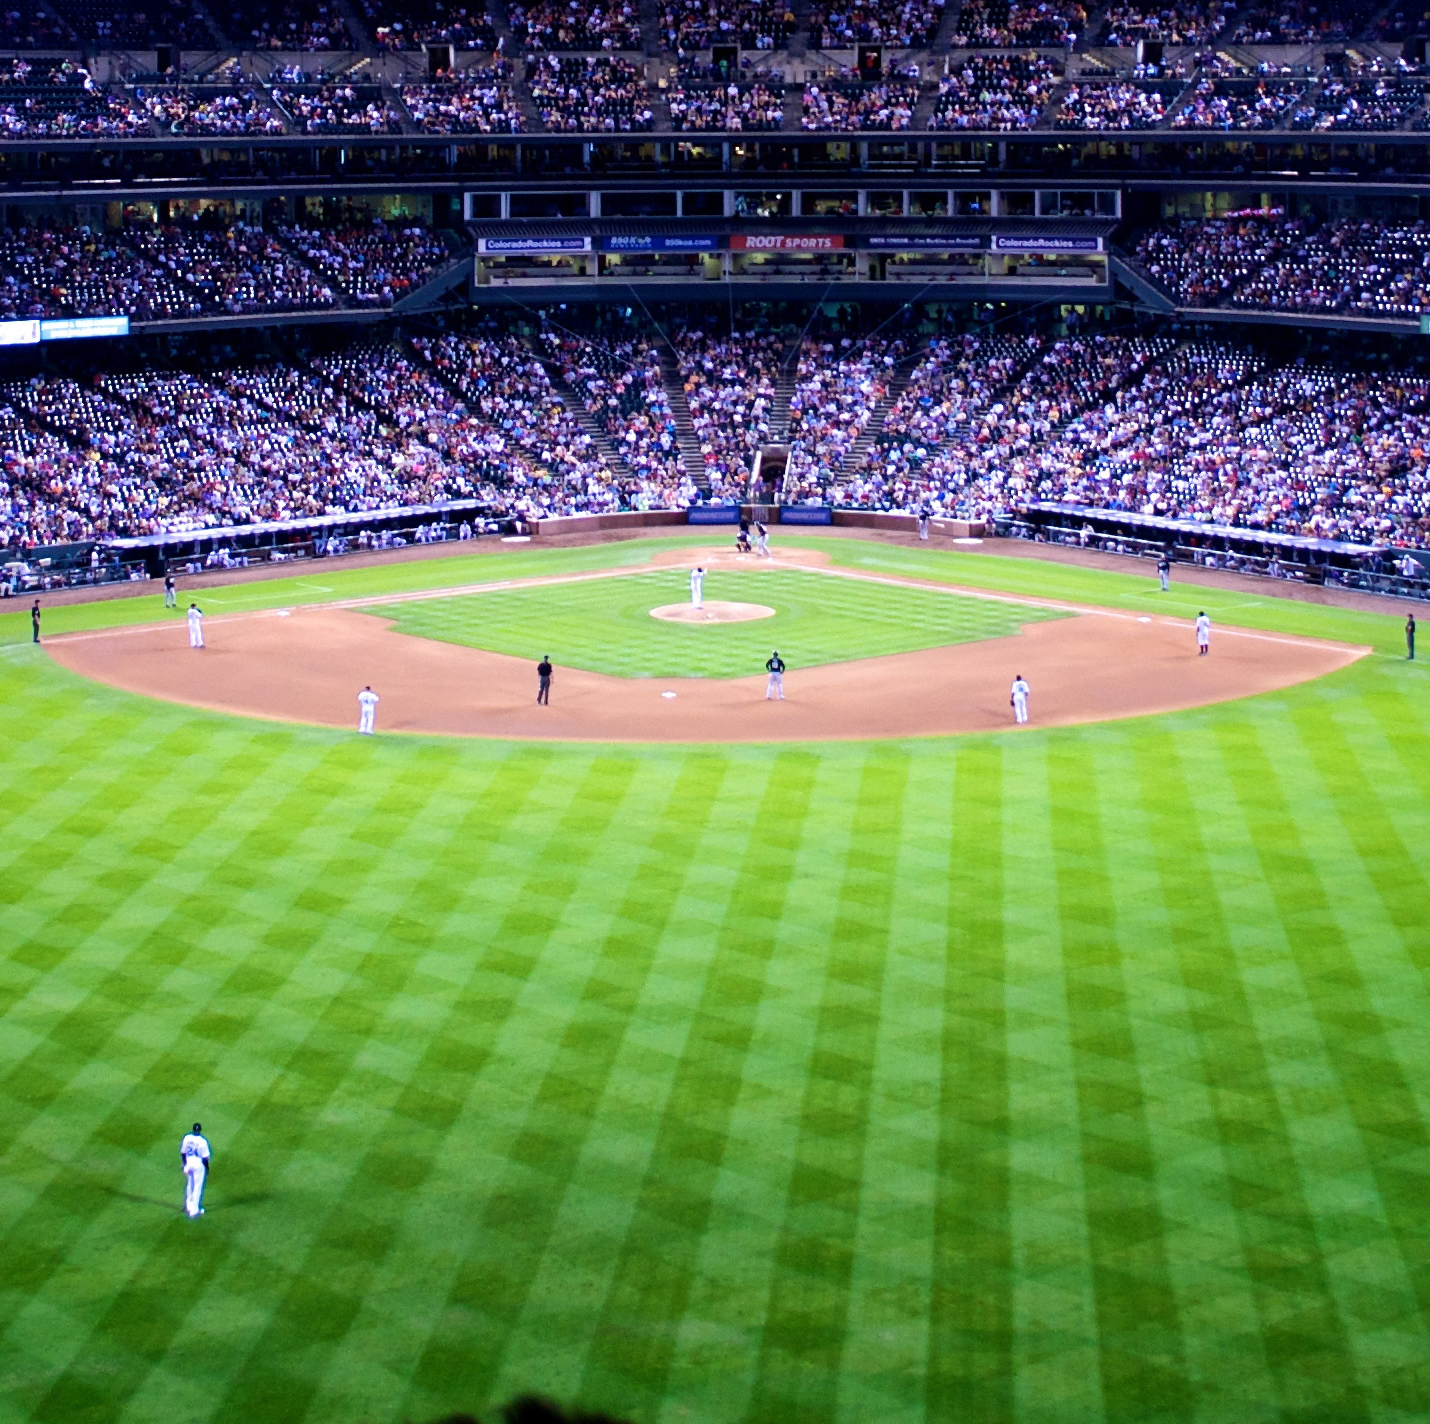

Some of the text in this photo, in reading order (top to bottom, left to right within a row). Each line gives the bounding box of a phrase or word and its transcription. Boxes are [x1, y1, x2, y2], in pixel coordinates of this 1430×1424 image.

[487, 238, 583, 250] ColoradoRockies.com
[746, 236, 831, 248] ROOT SPORTS
[998, 237, 1096, 248] ColoradoRockies.com
